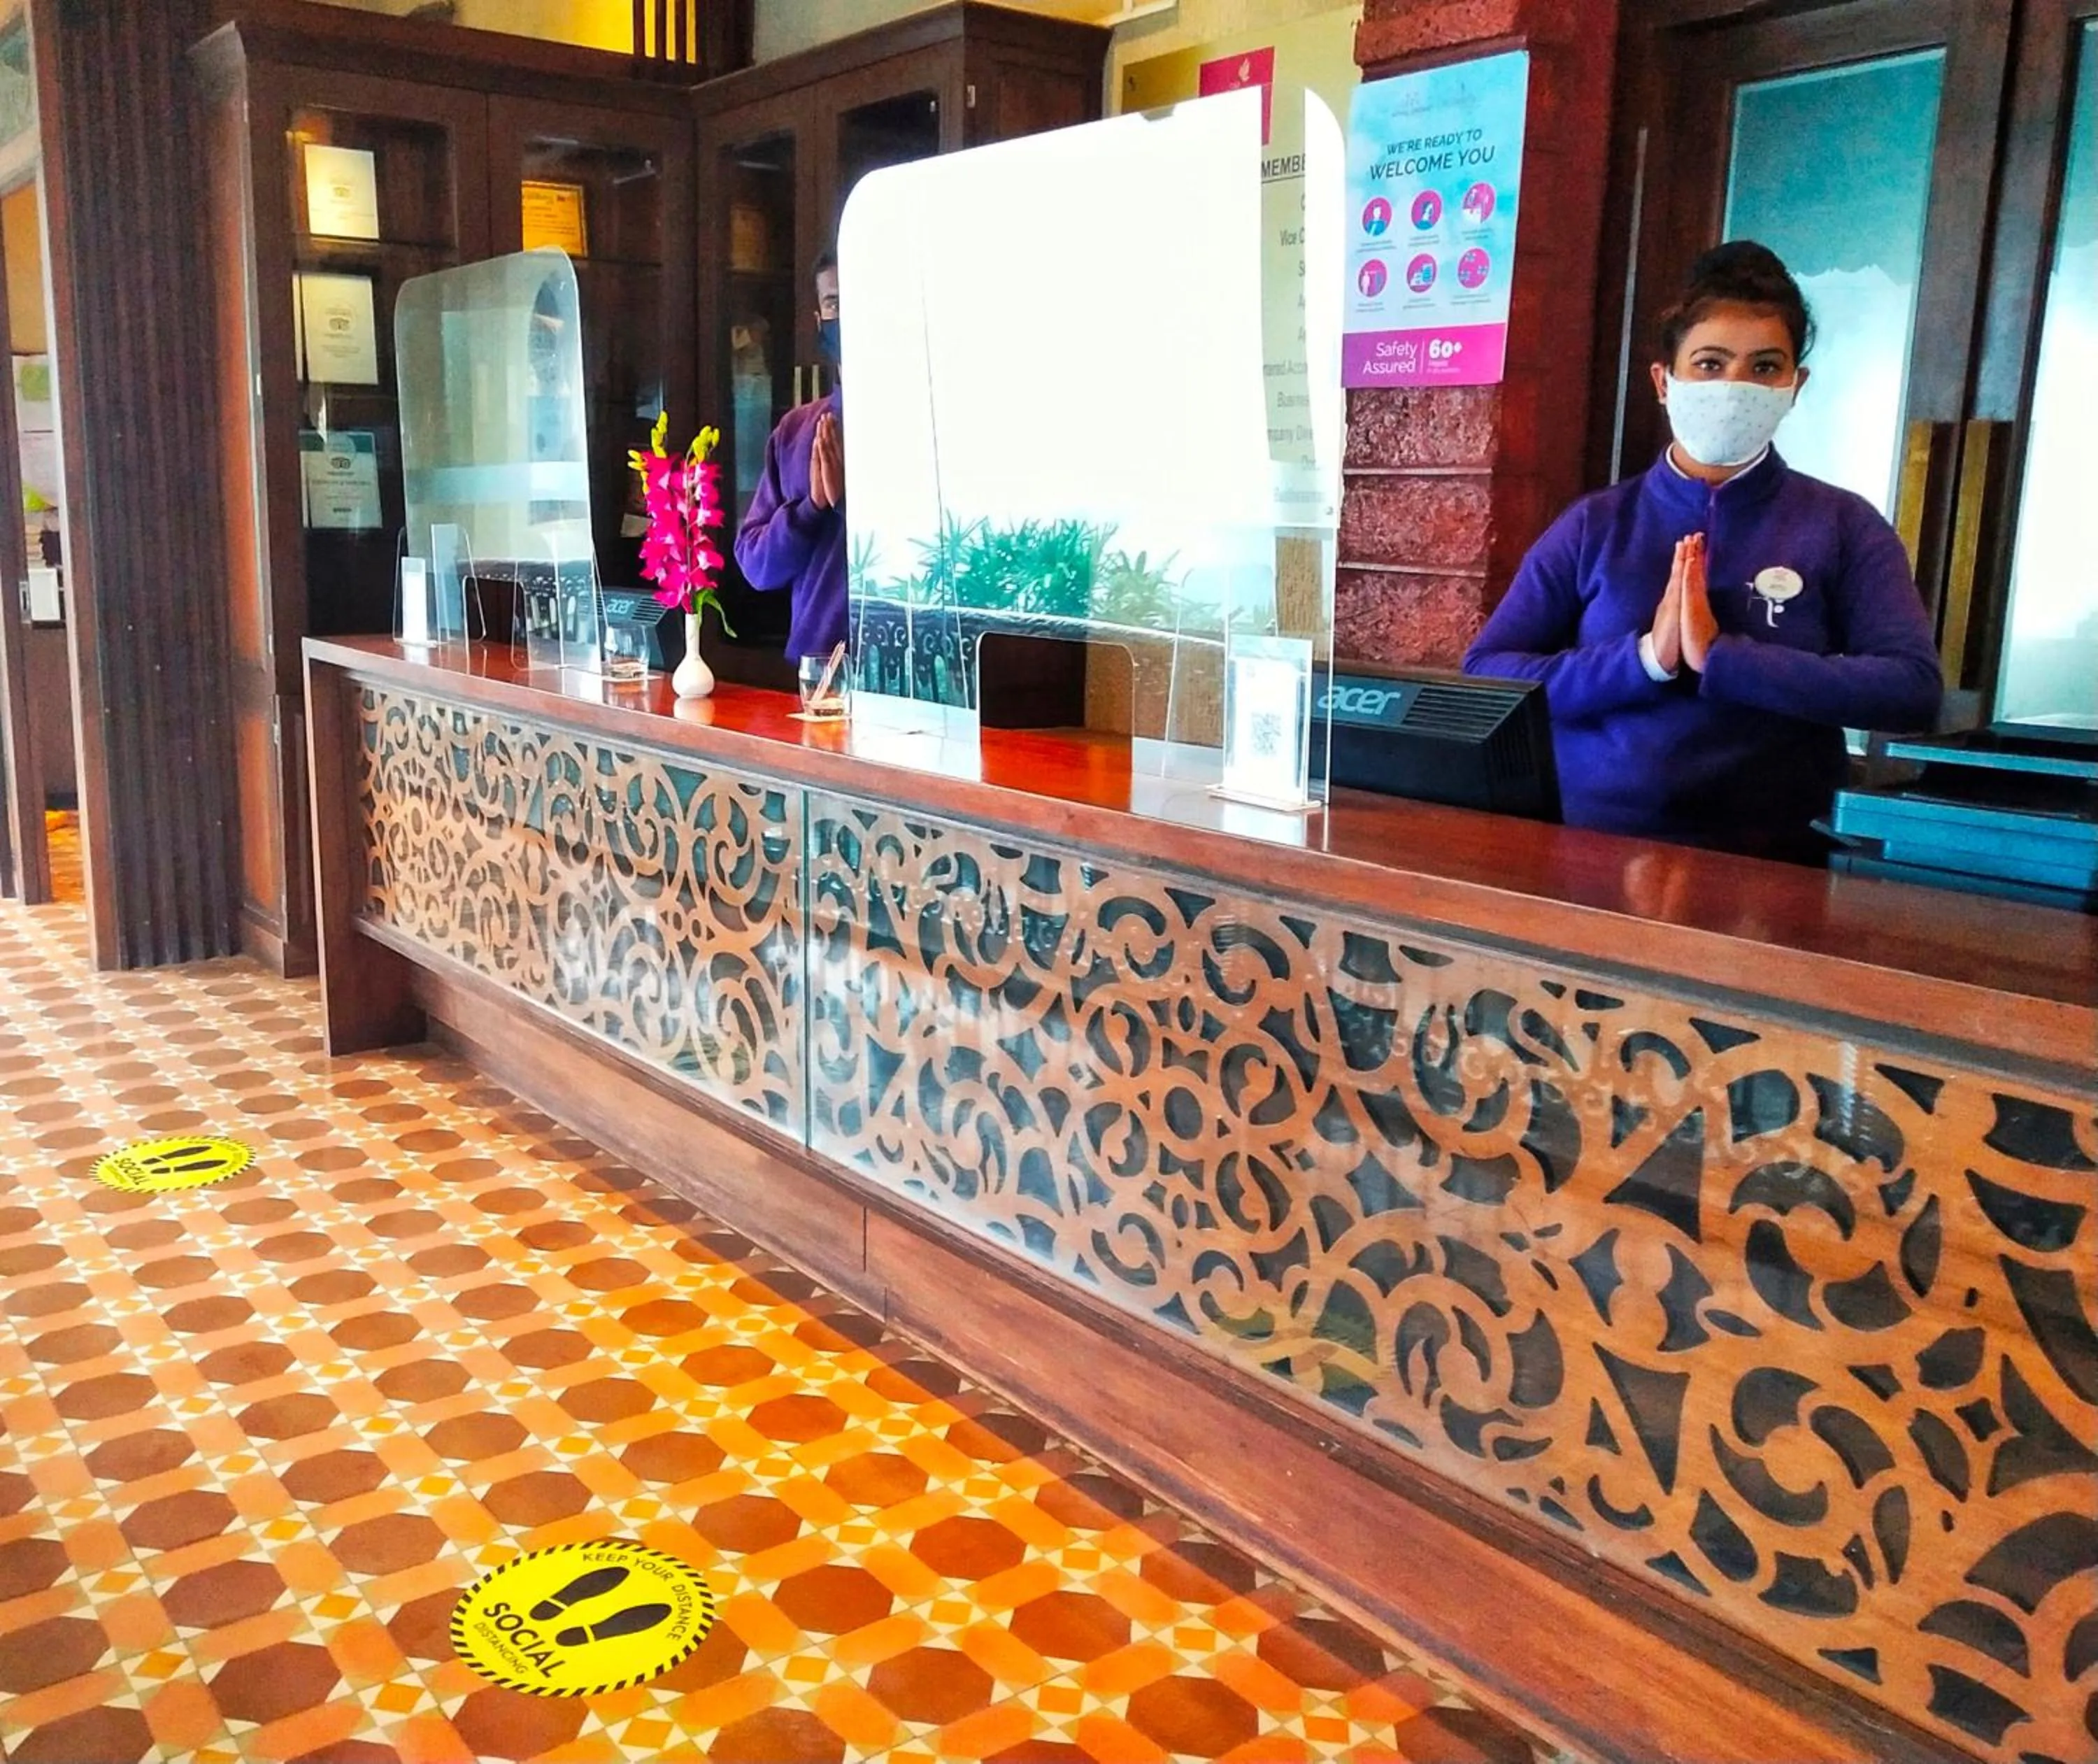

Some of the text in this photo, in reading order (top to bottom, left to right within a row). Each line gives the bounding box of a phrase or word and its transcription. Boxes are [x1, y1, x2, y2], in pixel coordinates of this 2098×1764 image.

[1425, 131, 1464, 149] READY
[1467, 129, 1483, 141] TO
[1369, 145, 1495, 180] WELCOME YOU
[1376, 341, 1418, 359] Safety
[1362, 358, 1416, 375] Assured
[606, 598, 634, 614] acer
[1317, 685, 1401, 715] acer
[583, 1553, 692, 1641] KEEP YOUR DISTANCE
[473, 1621, 529, 1674] DISTANCING
[483, 1602, 566, 1678] SOCIAL
